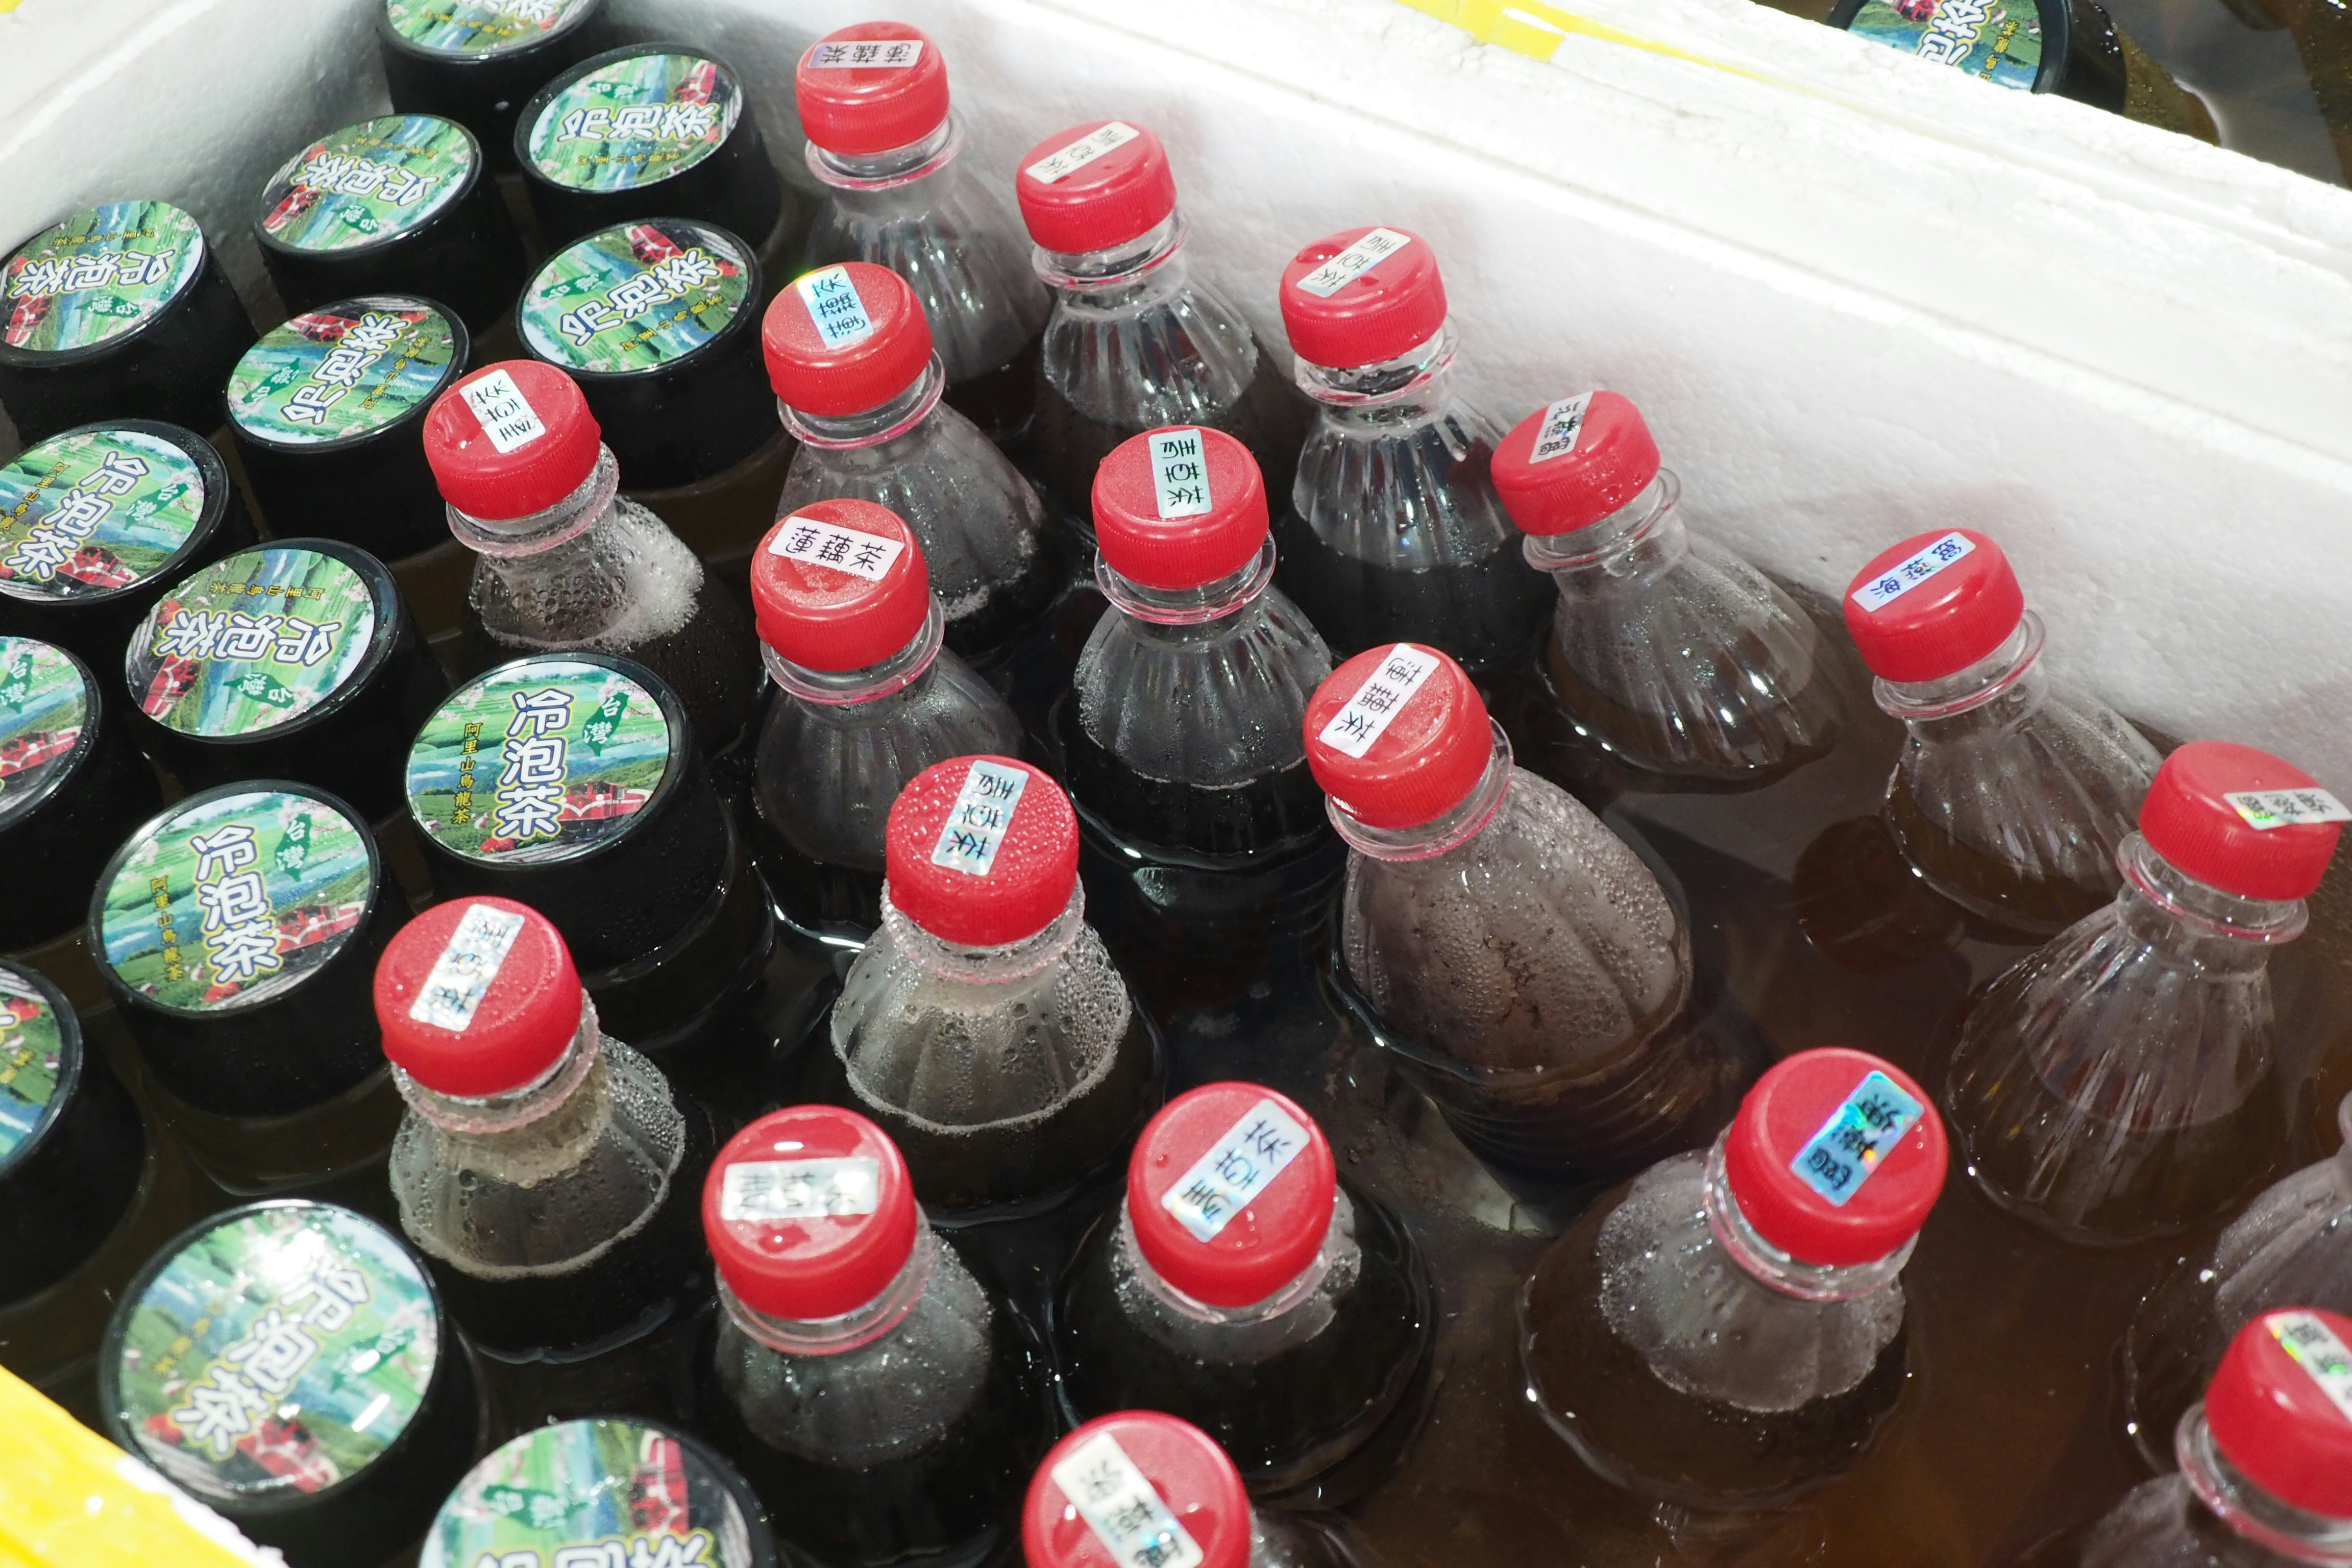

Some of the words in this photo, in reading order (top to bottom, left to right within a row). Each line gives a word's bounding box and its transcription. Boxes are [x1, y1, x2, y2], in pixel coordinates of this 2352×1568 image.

[821, 44, 910, 63] 蓮藕茶
[557, 104, 717, 142] 冷泡茶
[1038, 128, 1123, 174] 青草茶
[292, 153, 439, 206] 冷泡茶
[8, 249, 176, 298] 冷泡茶
[1310, 235, 1395, 287] 青草茶
[560, 248, 721, 347] 冷泡茶
[812, 273, 866, 338] 蓮藕茶
[280, 312, 410, 426] 冷泡茶
[475, 380, 534, 441] 青草茶
[0, 461, 70, 535] 阿里山烏龍
[1160, 438, 1205, 506] 青草茶
[5, 451, 150, 580] 冷泡茶
[785, 526, 887, 571] 蓮藕茶
[156, 609, 343, 666] 冷泡茶
[584, 696, 621, 745] 台灣
[1335, 657, 1423, 742] 蓮藕茶
[494, 688, 574, 839] 冷泡茶
[275, 820, 306, 872] 台灣
[946, 773, 1015, 859] 青草茶
[190, 824, 283, 984] 冷泡茶
[1182, 1120, 1291, 1219] 青草茶
[171, 1253, 371, 1455] 冷泡茶
